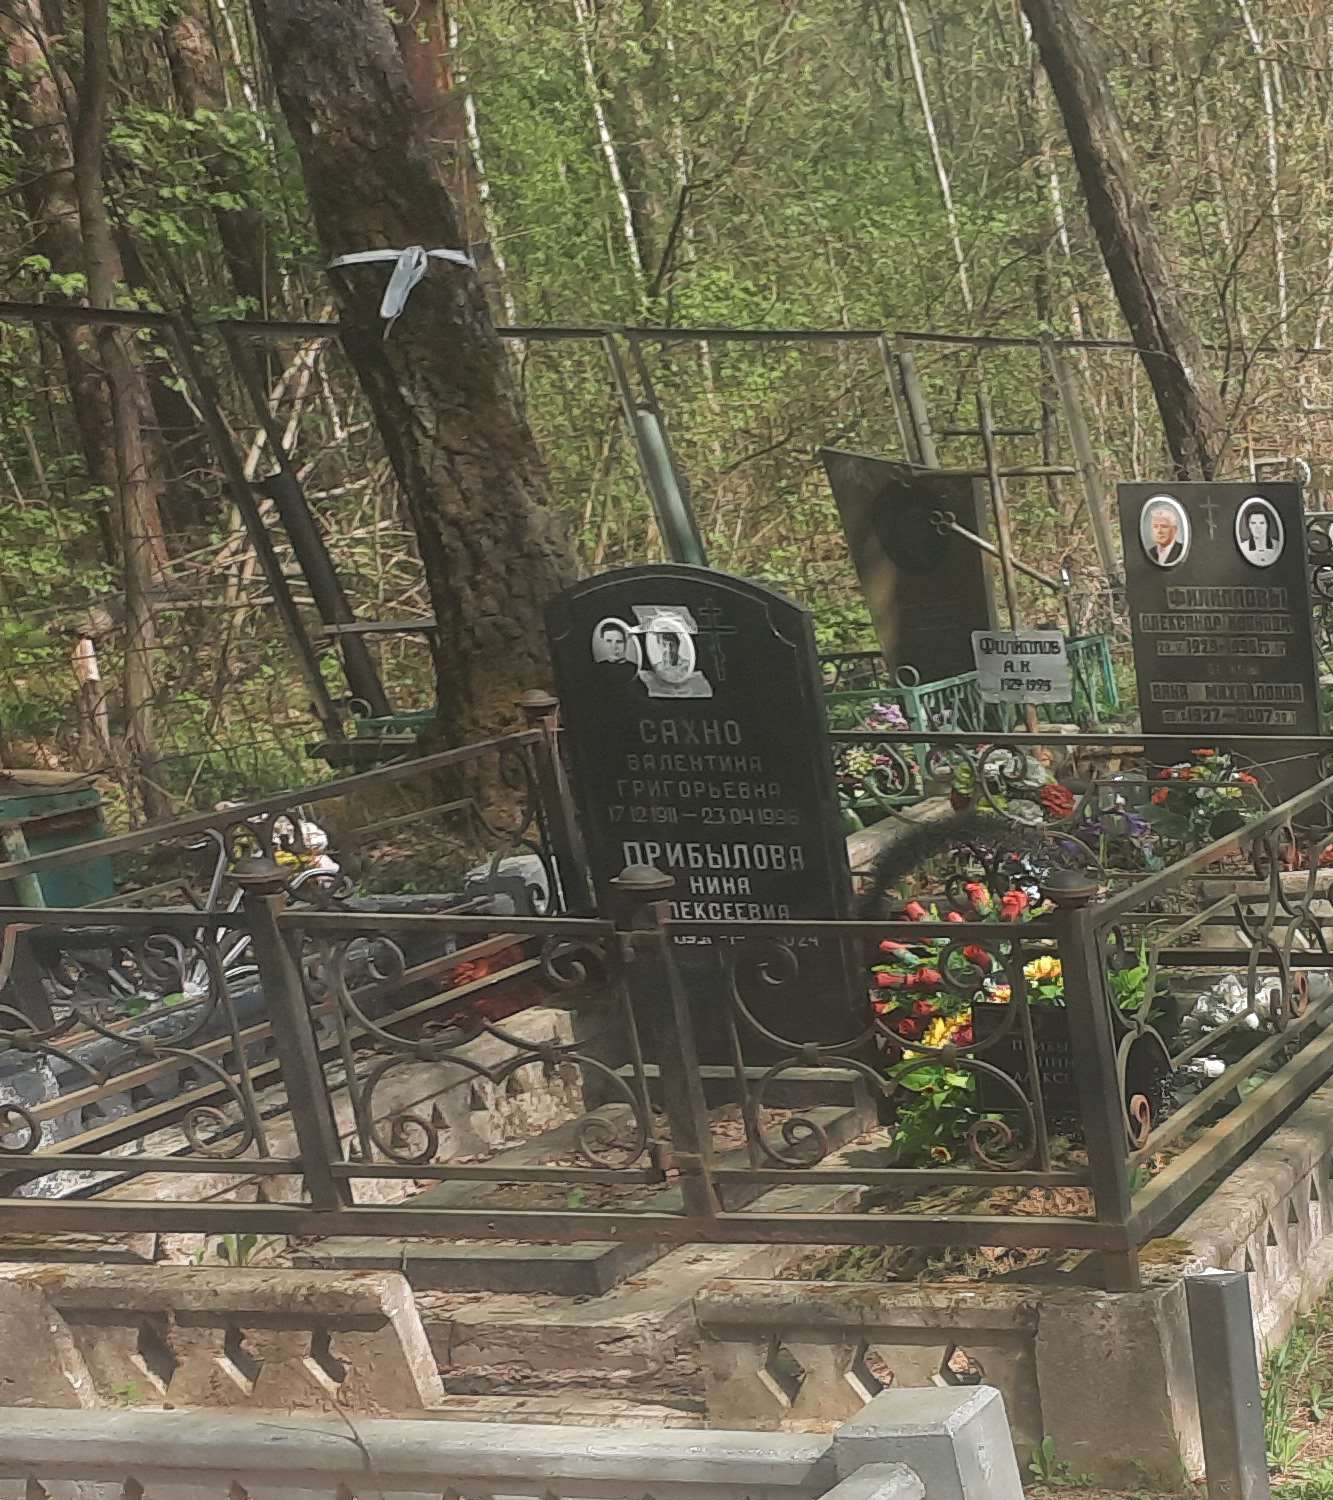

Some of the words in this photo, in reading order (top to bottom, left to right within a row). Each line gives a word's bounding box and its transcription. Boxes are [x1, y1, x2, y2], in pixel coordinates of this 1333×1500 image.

[639, 719, 742, 746] САХНО
[626, 754, 764, 774] ВАЛЕНТИНА
[616, 778, 782, 799] ГРИГОРЬЕВНА
[622, 840, 806, 872] ПРИБЫЛОВА
[689, 875, 752, 896] НИНА
